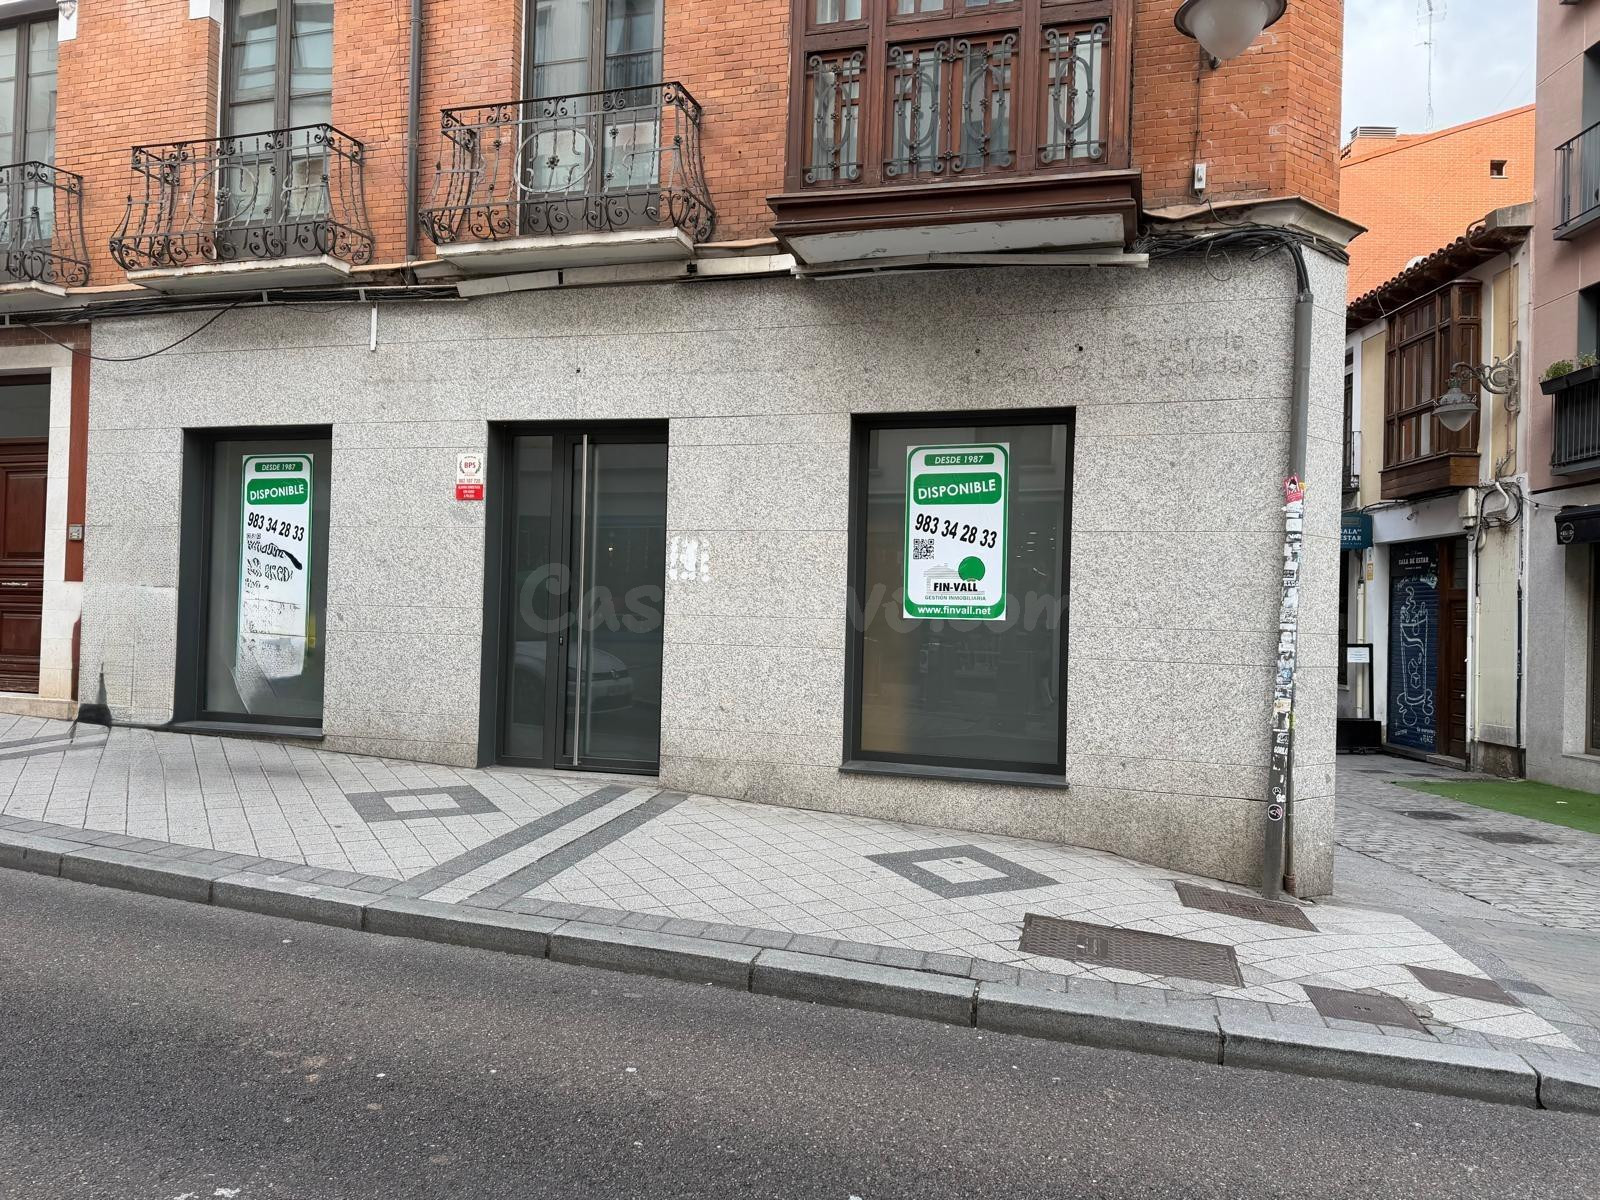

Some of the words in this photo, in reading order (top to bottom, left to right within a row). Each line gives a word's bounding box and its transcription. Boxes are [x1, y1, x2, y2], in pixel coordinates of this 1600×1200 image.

[934, 456, 961, 465] DESDE
[964, 455, 984, 464] 1987
[261, 463, 280, 471] DESDE
[281, 463, 296, 471] 1987
[249, 484, 305, 501] DISPONIBLE
[917, 478, 996, 500] DISPONIBLE
[247, 512, 265, 530] 983
[265, 517, 278, 534] 34
[278, 521, 291, 538] 28
[292, 525, 305, 542] 33
[914, 513, 939, 534] 983
[941, 519, 959, 539] 34
[959, 524, 978, 544] 28
[979, 529, 997, 549] 33
[933, 582, 978, 592] FIN-VALL
[917, 605, 991, 615] www.finvall.net
